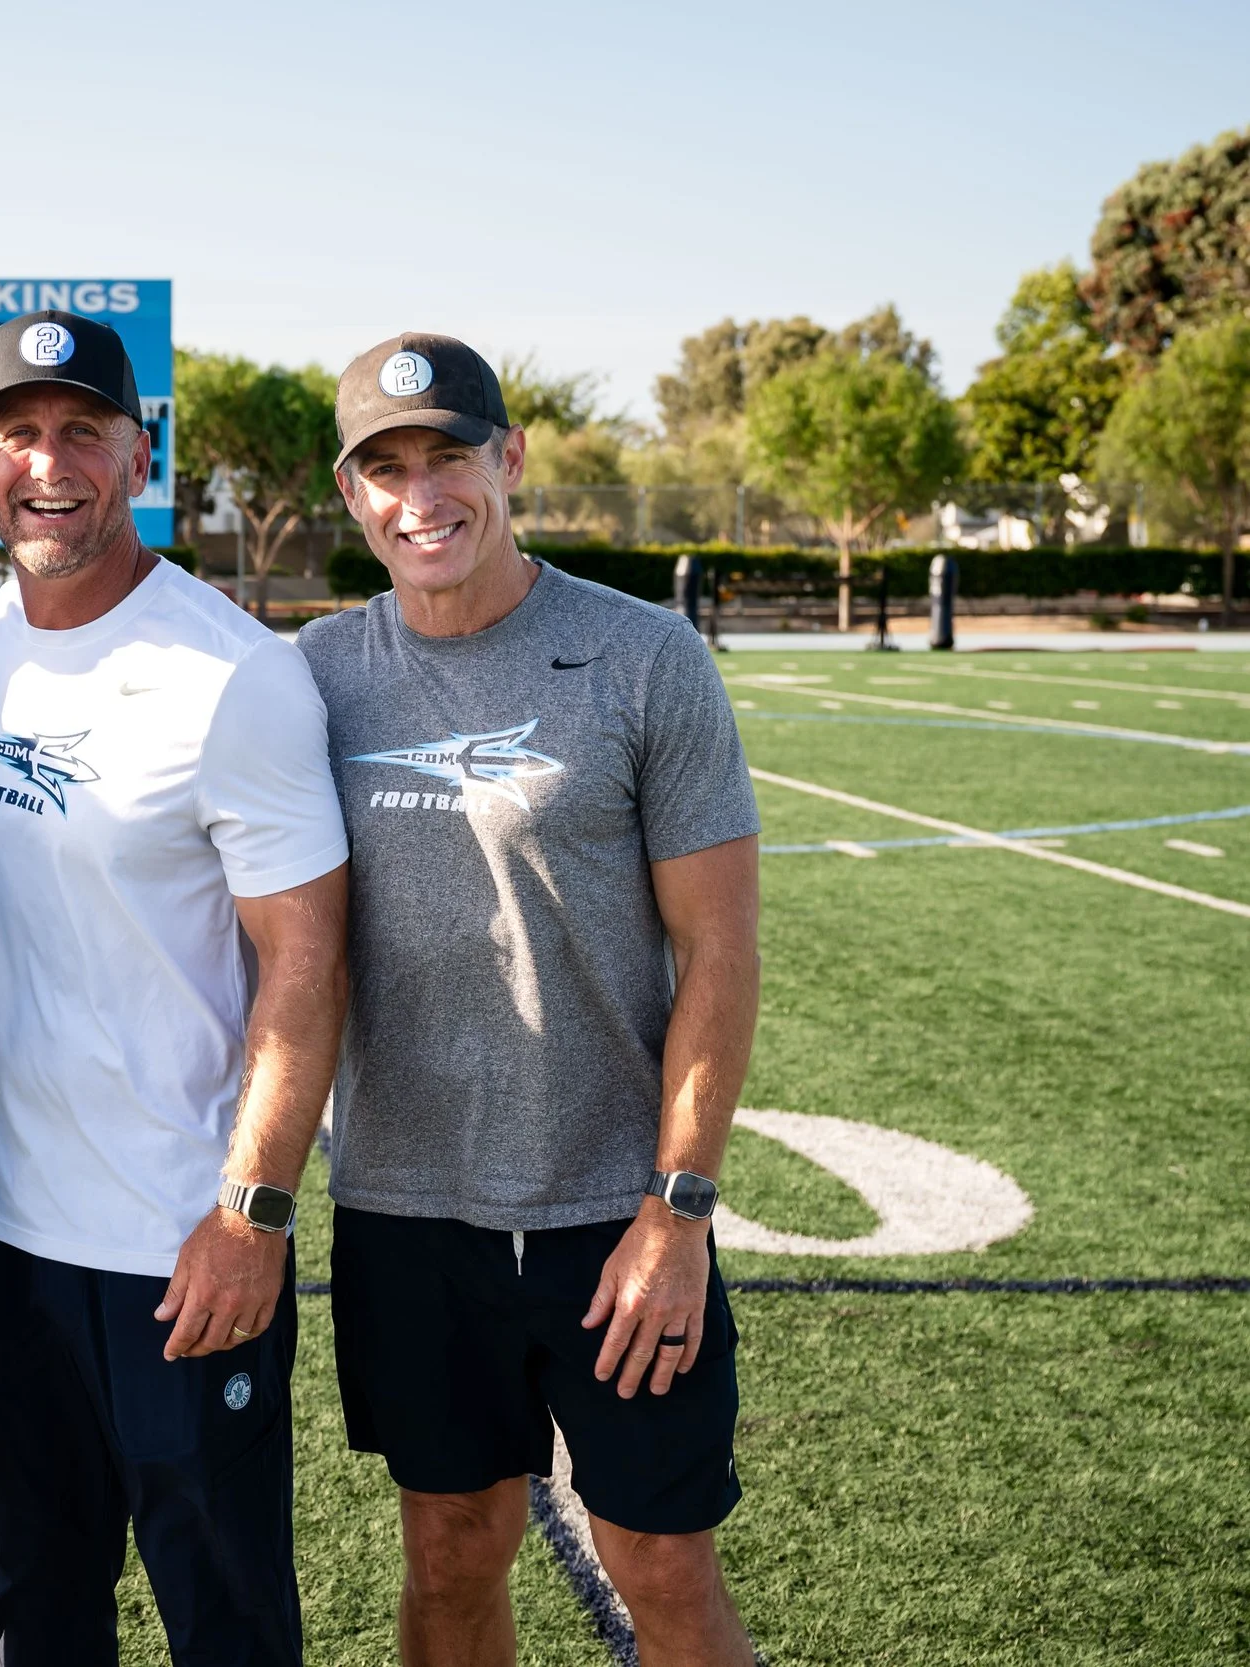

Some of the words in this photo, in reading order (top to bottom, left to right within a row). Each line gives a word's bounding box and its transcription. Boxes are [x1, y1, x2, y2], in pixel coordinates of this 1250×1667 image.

[36, 326, 59, 360] 2
[394, 356, 419, 392] 2
[411, 752, 455, 765] CDM
[370, 791, 490, 814] FOOTBA
